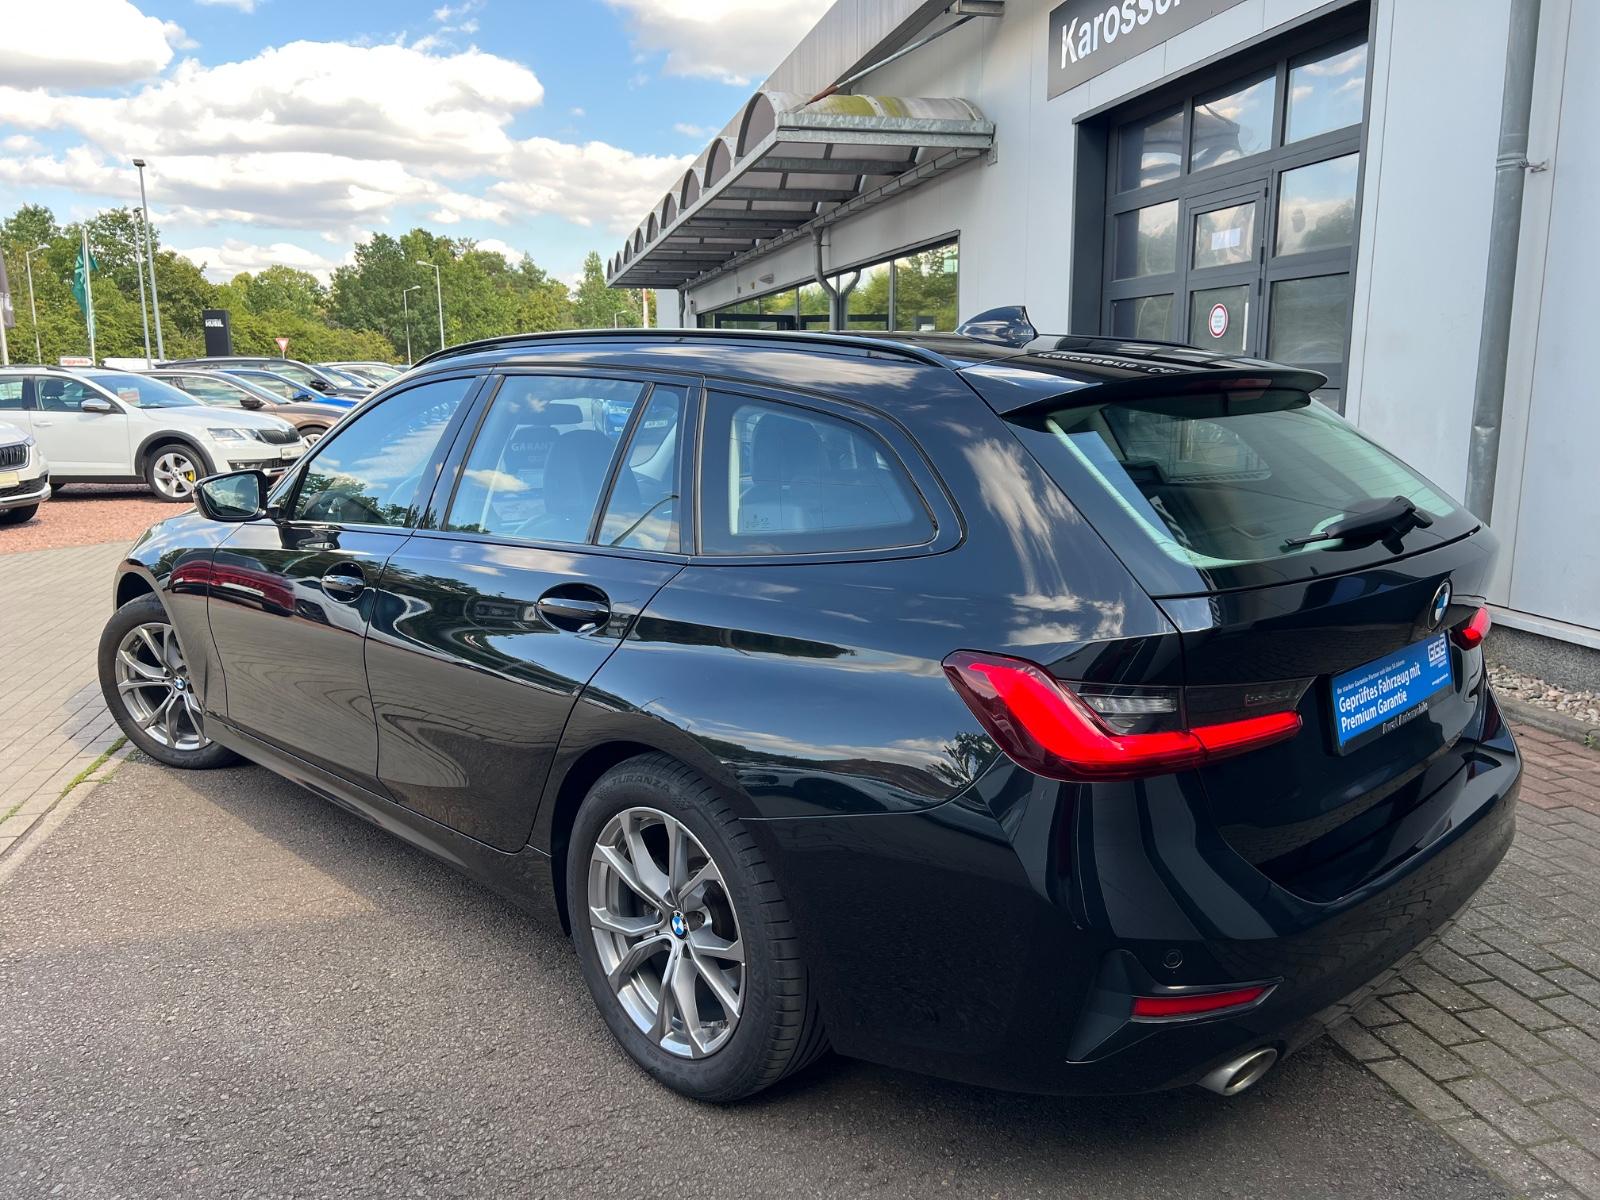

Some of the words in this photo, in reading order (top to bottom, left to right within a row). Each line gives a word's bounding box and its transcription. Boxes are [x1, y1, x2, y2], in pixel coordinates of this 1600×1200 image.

[1061, 0, 1180, 70] Kaross
[1339, 686, 1379, 713] Geprüftes
[1378, 671, 1410, 695] Fahrzeug
[1410, 662, 1421, 679] mit
[1341, 705, 1378, 732] Premium
[1378, 689, 1408, 714] Garantie
[611, 774, 670, 793] TURANZA
